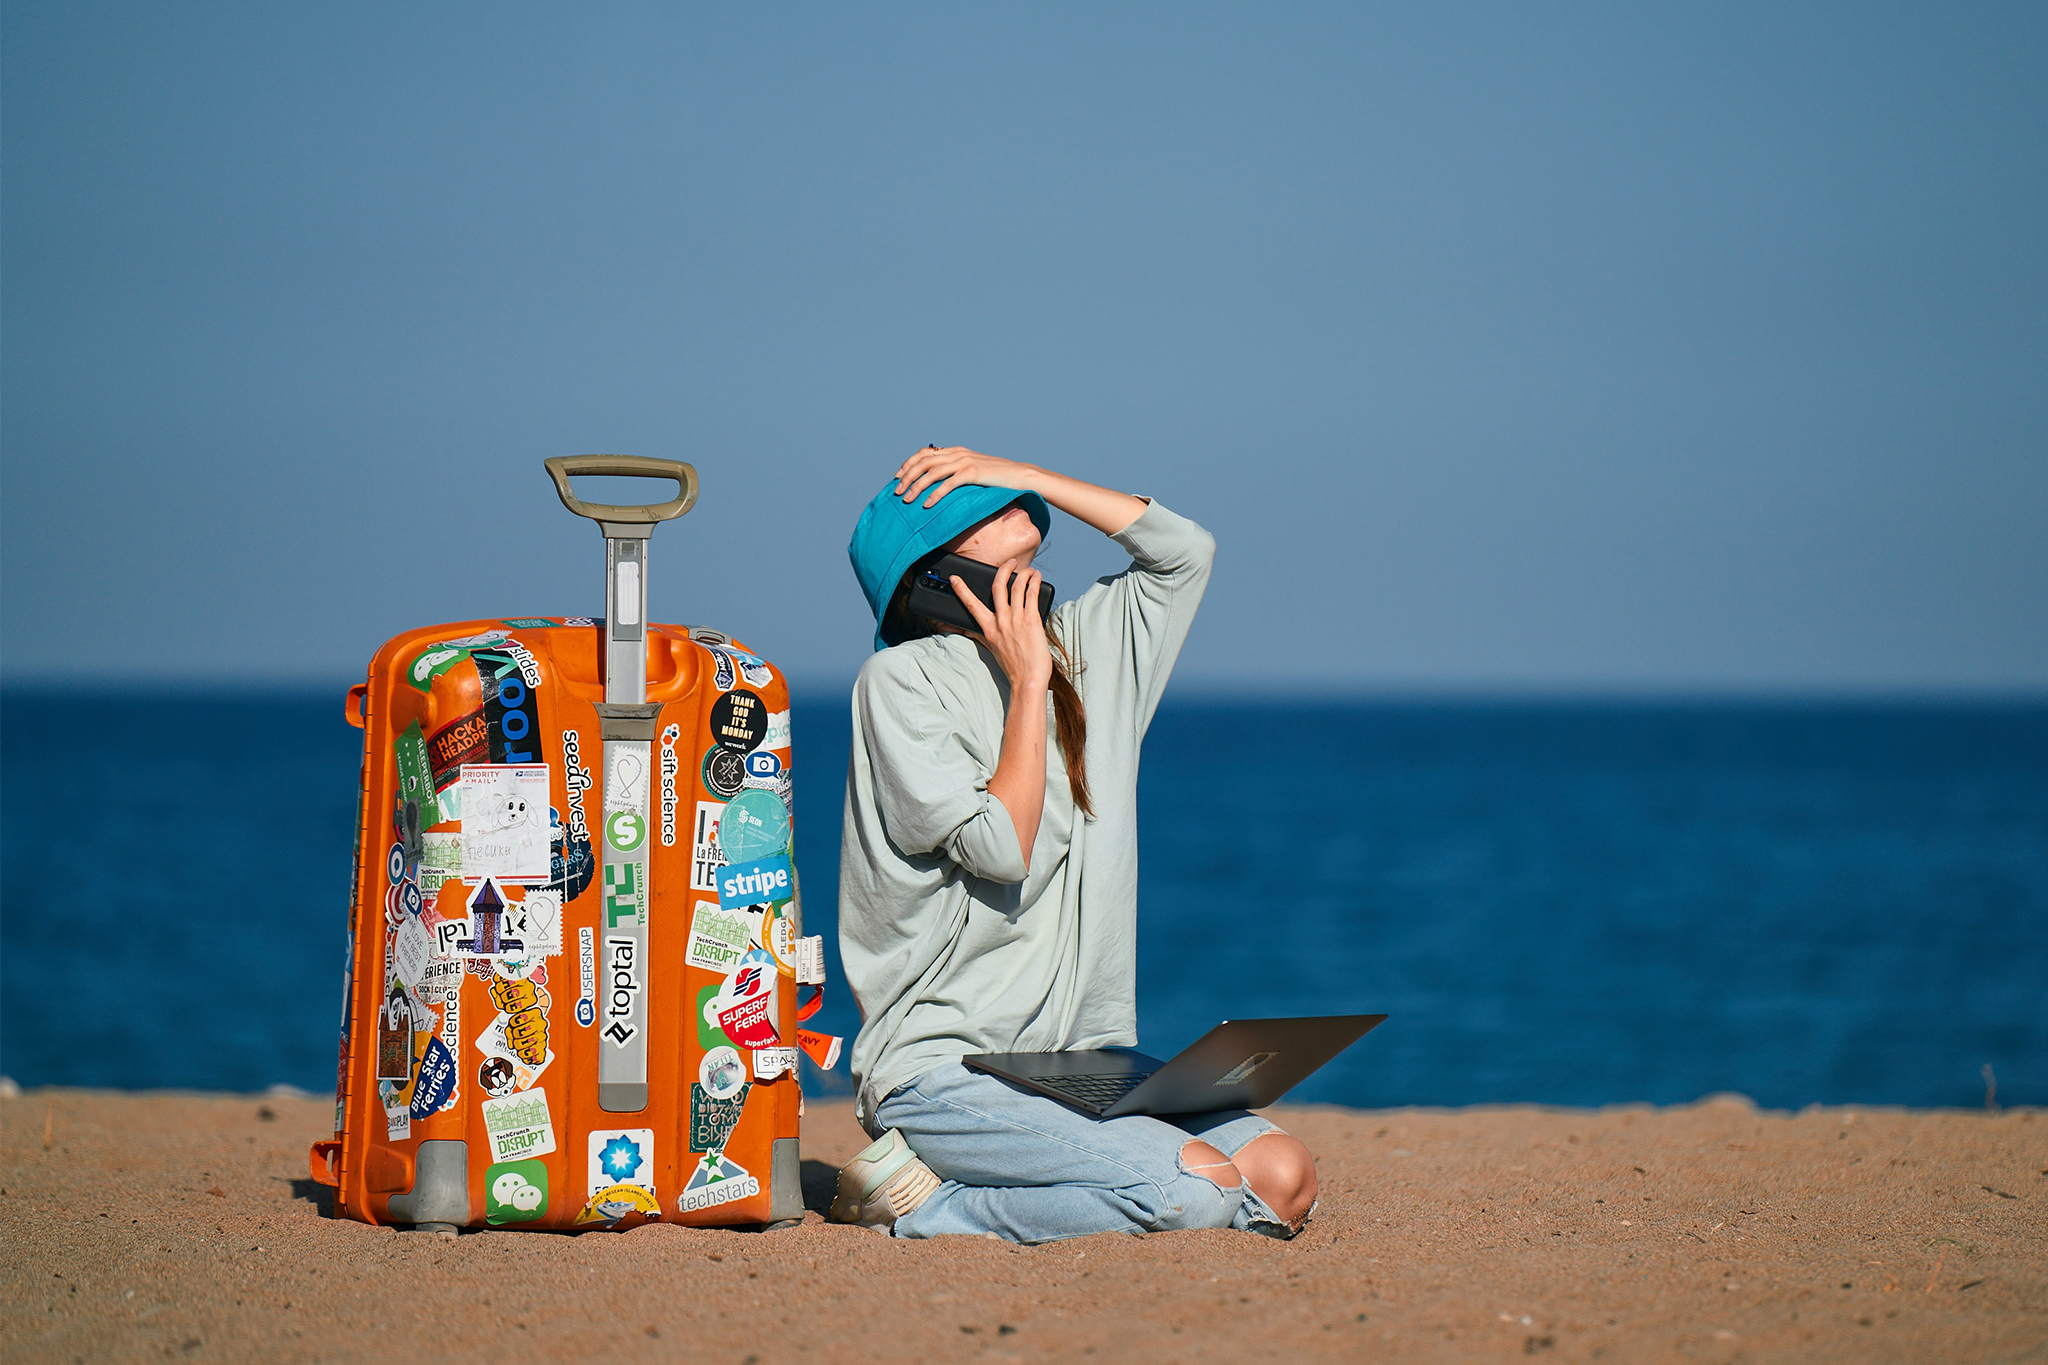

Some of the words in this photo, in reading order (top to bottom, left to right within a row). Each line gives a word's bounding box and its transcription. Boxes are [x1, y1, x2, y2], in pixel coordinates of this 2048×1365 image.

[510, 646, 540, 686] slides
[730, 694, 755, 709] THANK
[733, 706, 749, 718] GOD
[437, 714, 486, 751] HACKA
[721, 725, 754, 740] MONDAY
[731, 717, 747, 728] IT'S
[724, 741, 747, 750] wework
[417, 737, 434, 804] SLEEPERBOT
[663, 749, 677, 775] sift
[743, 778, 781, 789] USERSNAP
[663, 777, 677, 844] science
[748, 815, 763, 828] SEON
[696, 846, 706, 859] La
[635, 862, 646, 926] TechCrunch
[724, 867, 788, 898] stripe
[409, 944, 423, 963] BEST
[693, 942, 741, 965] DISRUPT
[696, 936, 728, 948] TechCrunch
[581, 929, 594, 999] USERSNAP
[609, 940, 637, 1018] toptal
[707, 1053, 734, 1072] TITAN
[411, 1080, 426, 1113] Blue
[422, 1045, 442, 1076] Star
[420, 1061, 451, 1112] Ferries
[496, 1127, 530, 1141] TechCrunch
[497, 1130, 546, 1155] DISRUPT
[680, 1179, 758, 1212] techstars
